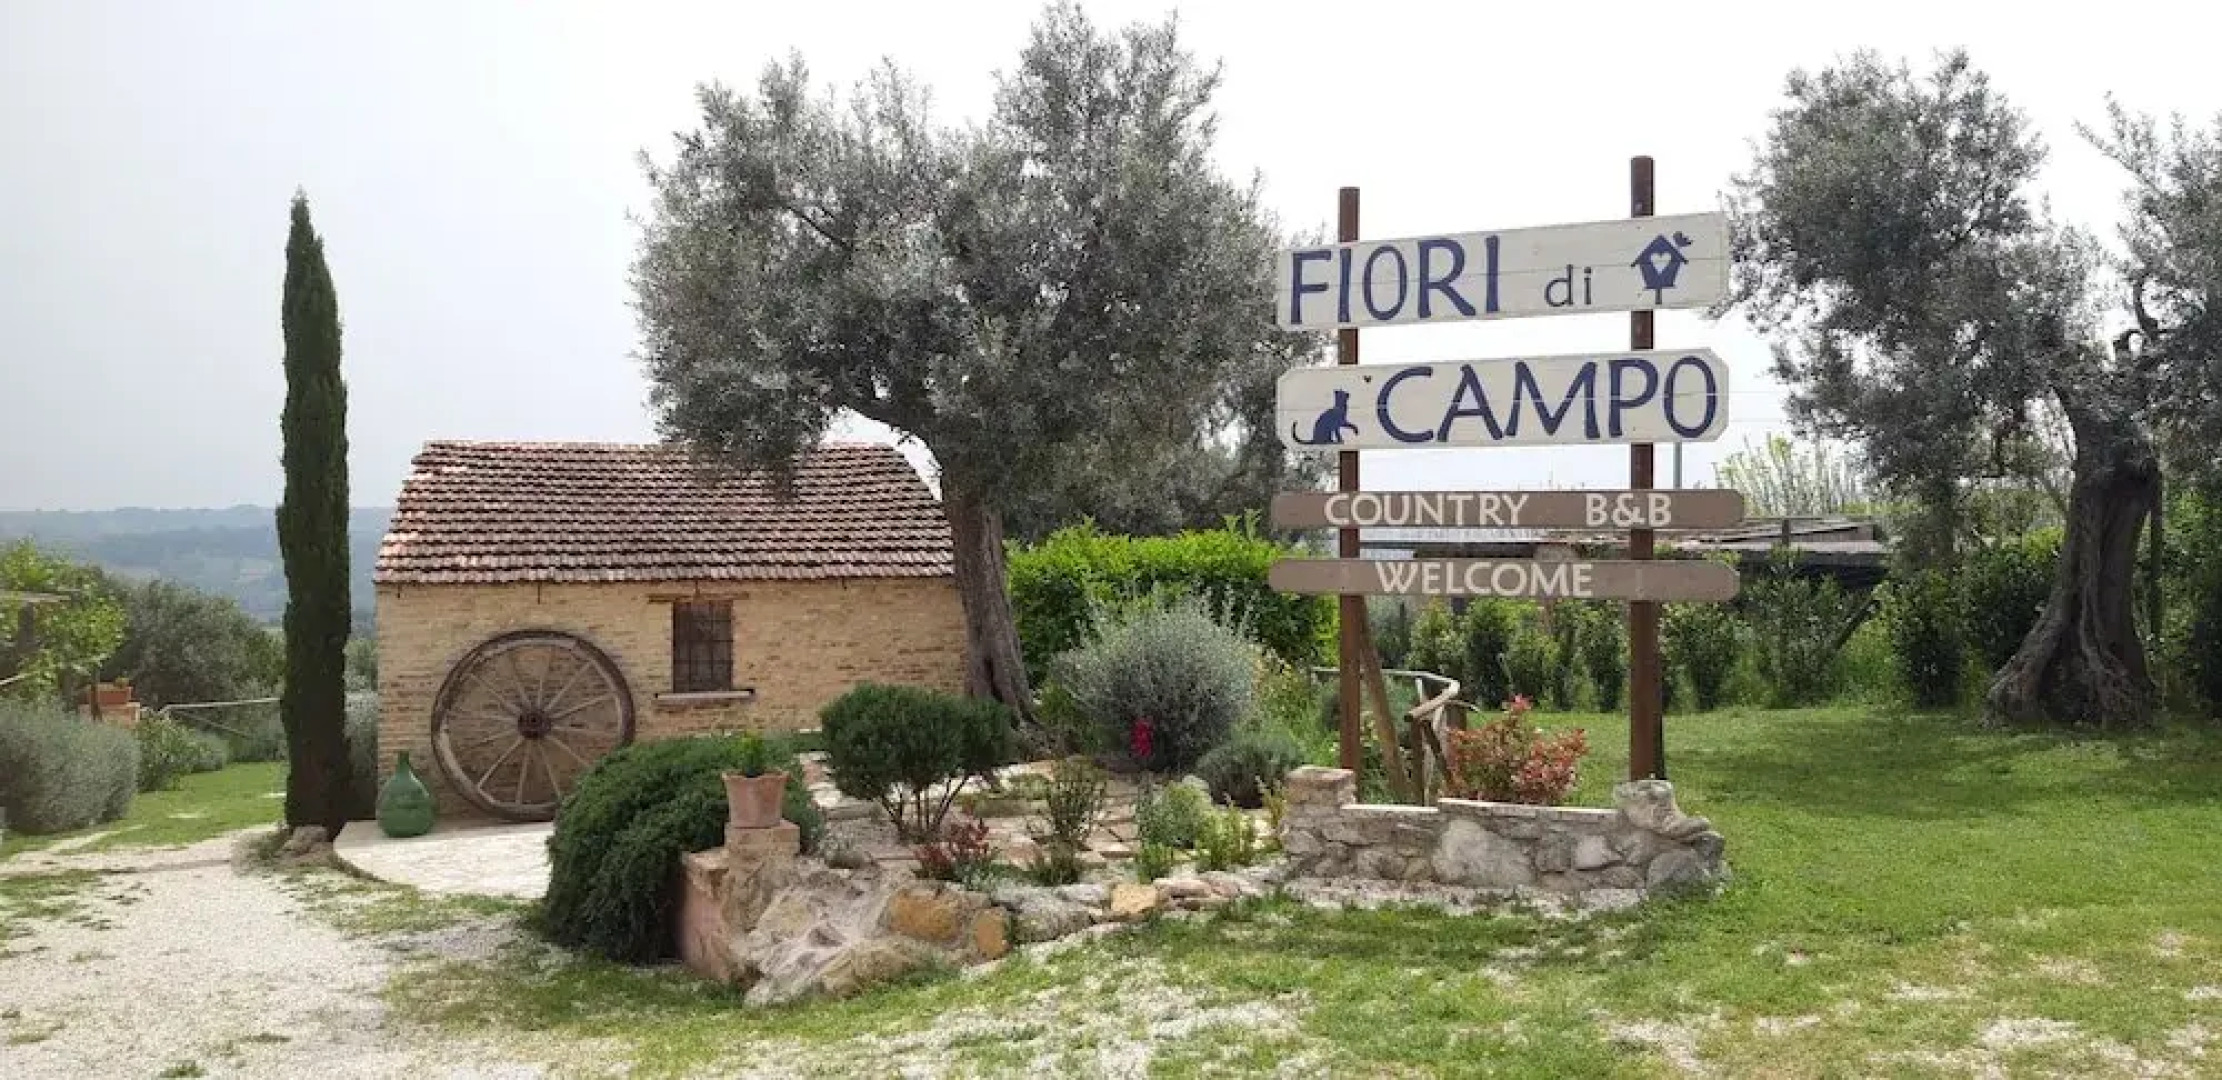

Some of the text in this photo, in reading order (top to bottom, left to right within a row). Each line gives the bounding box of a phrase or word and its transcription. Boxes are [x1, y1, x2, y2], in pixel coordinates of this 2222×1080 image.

[1290, 234, 1592, 325] FIORI di
[1376, 355, 1717, 443] CAMPO
[1324, 493, 1672, 527] COUNTRY B&B
[1374, 561, 1593, 597] WELCOME
